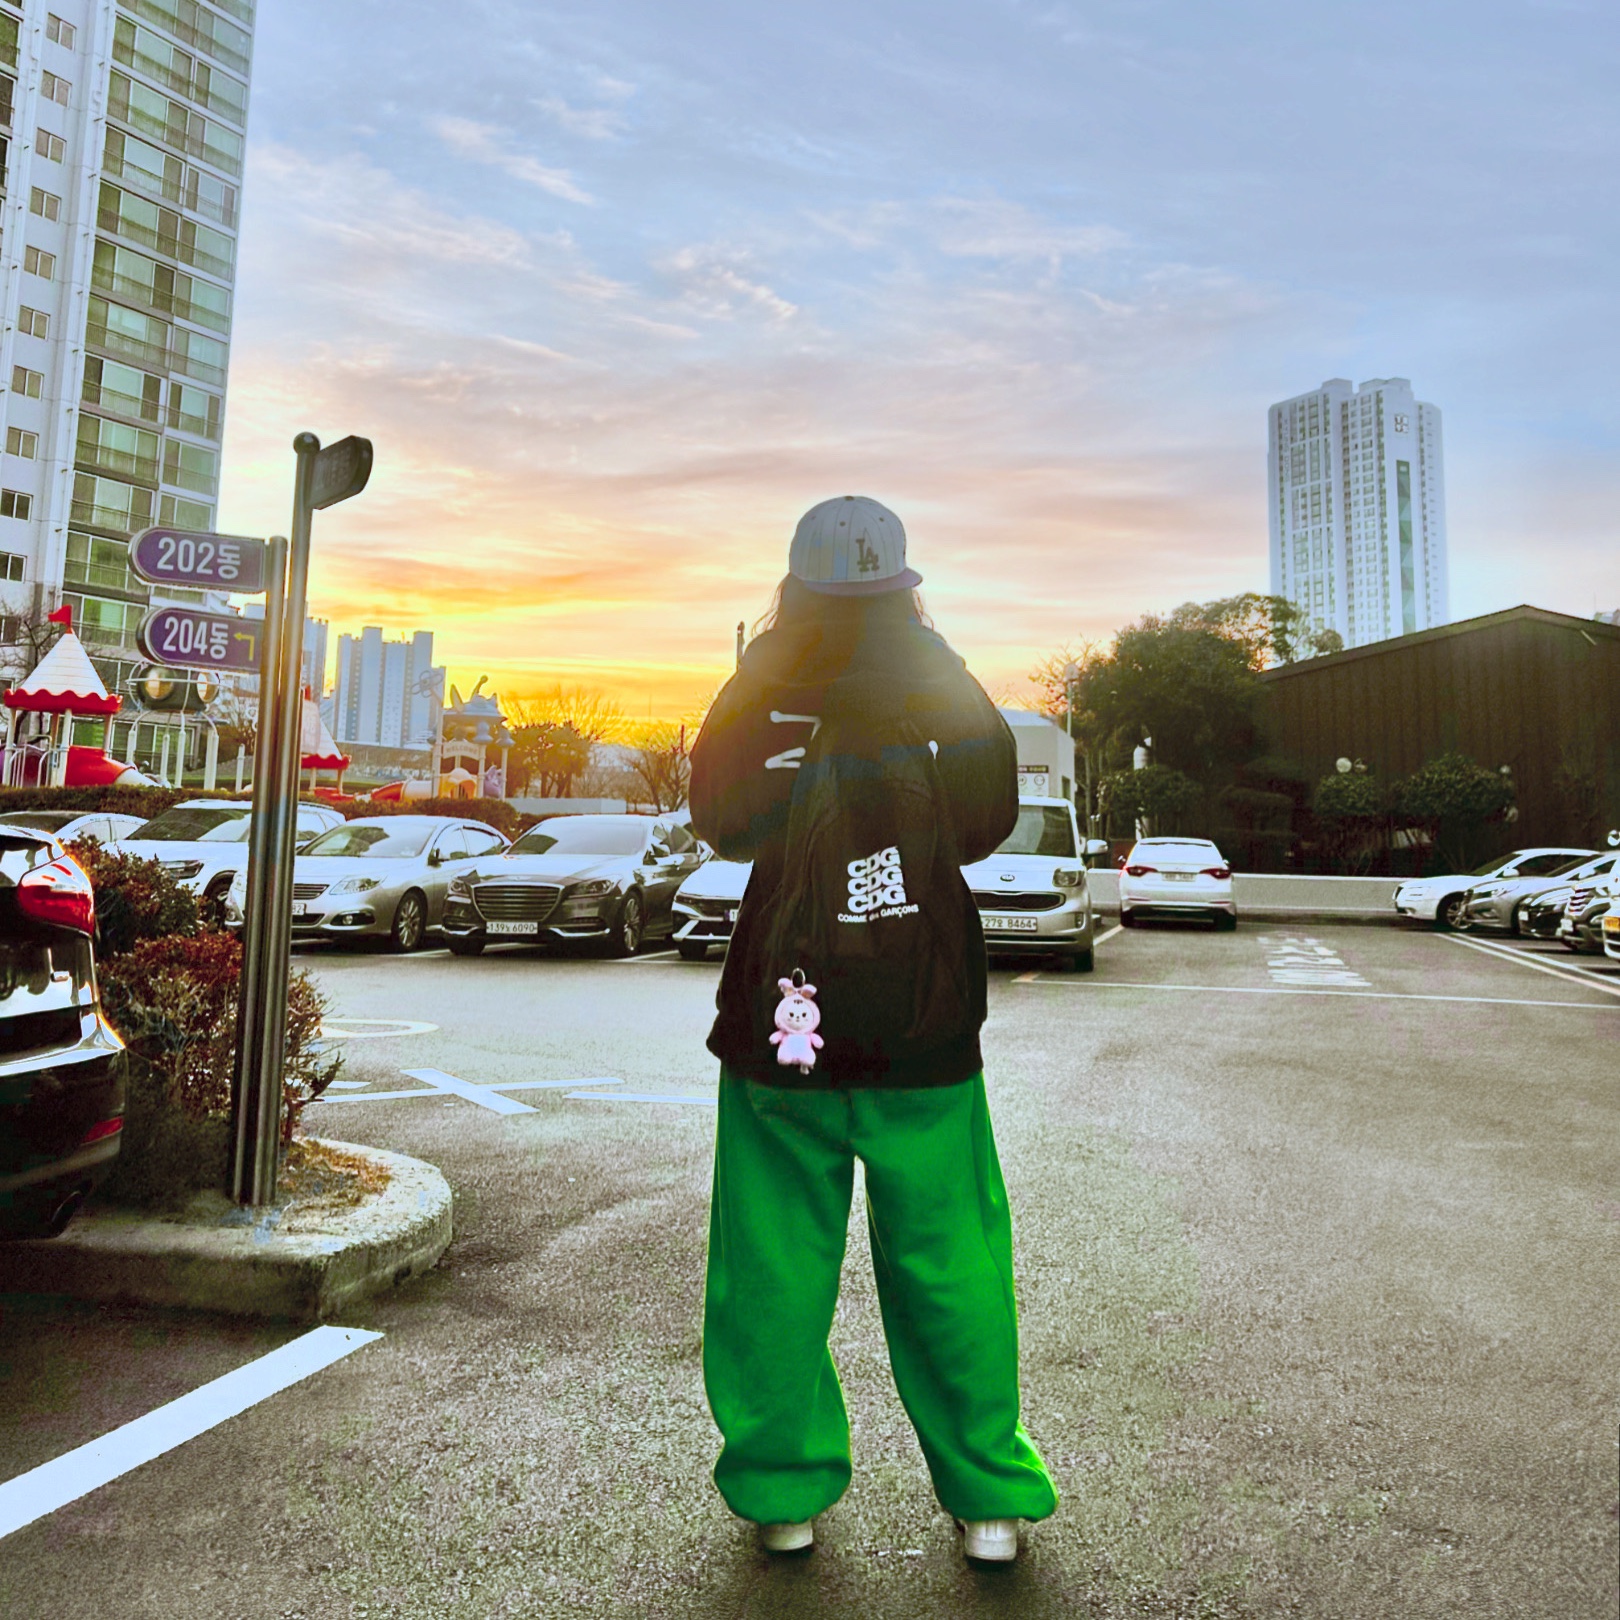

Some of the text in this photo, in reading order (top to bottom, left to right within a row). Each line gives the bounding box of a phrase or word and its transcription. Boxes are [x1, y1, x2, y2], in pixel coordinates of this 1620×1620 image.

[157, 537, 241, 580] 202동
[855, 538, 880, 573] LA
[163, 616, 229, 660] 204동
[847, 845, 901, 878] CDG
[847, 865, 904, 896] CDG
[847, 884, 907, 914] CDG
[512, 923, 535, 932] 6090
[1007, 919, 1032, 928] 8464
